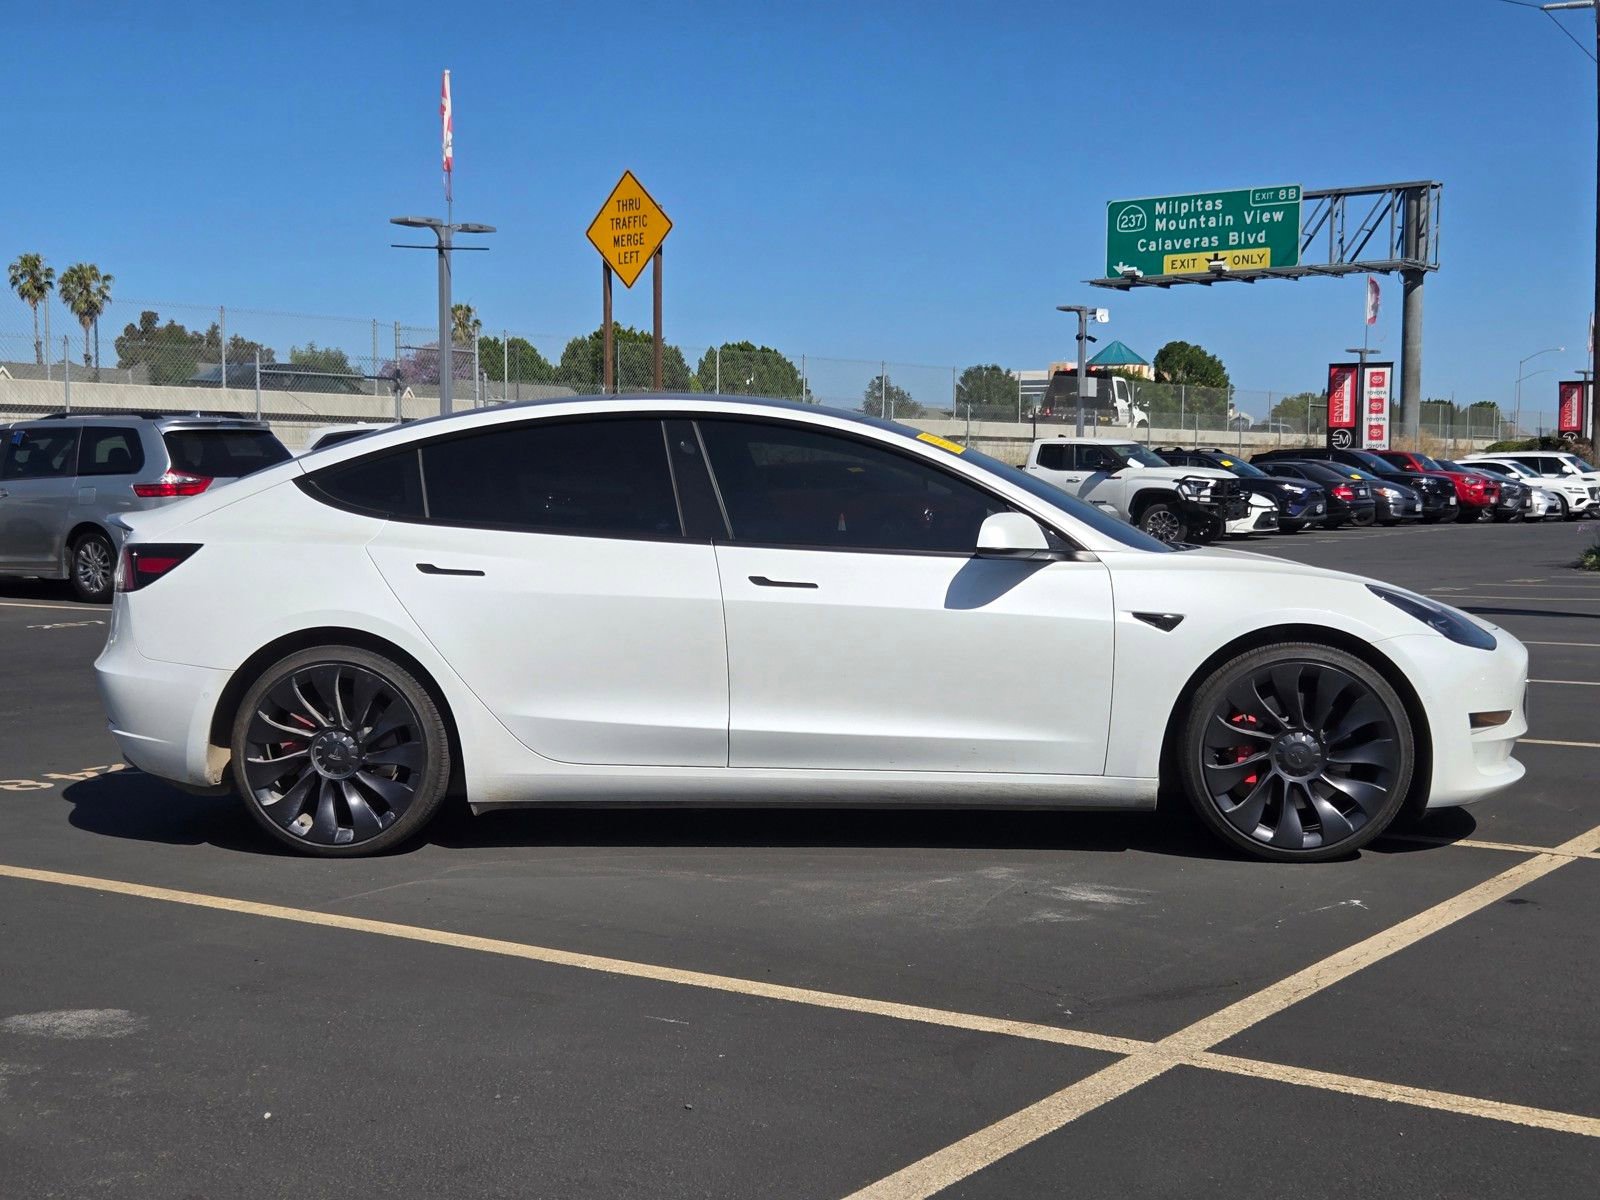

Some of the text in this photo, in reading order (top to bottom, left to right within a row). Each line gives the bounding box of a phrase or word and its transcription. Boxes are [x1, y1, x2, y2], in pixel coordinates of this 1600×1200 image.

[1255, 189, 1297, 201] EXIT 8B
[616, 198, 641, 212] THRU
[1155, 199, 1223, 216] Milpitas
[610, 215, 648, 231] TRAFFIC
[1120, 214, 1143, 229] 237
[1155, 210, 1284, 232] Mountain View
[613, 232, 645, 248] MERGE
[1137, 230, 1266, 252] Calaveras Blvd
[618, 250, 640, 265] LEFT
[1170, 253, 1265, 270] EXIT ONLY
[1333, 371, 1345, 423] ENVISION
